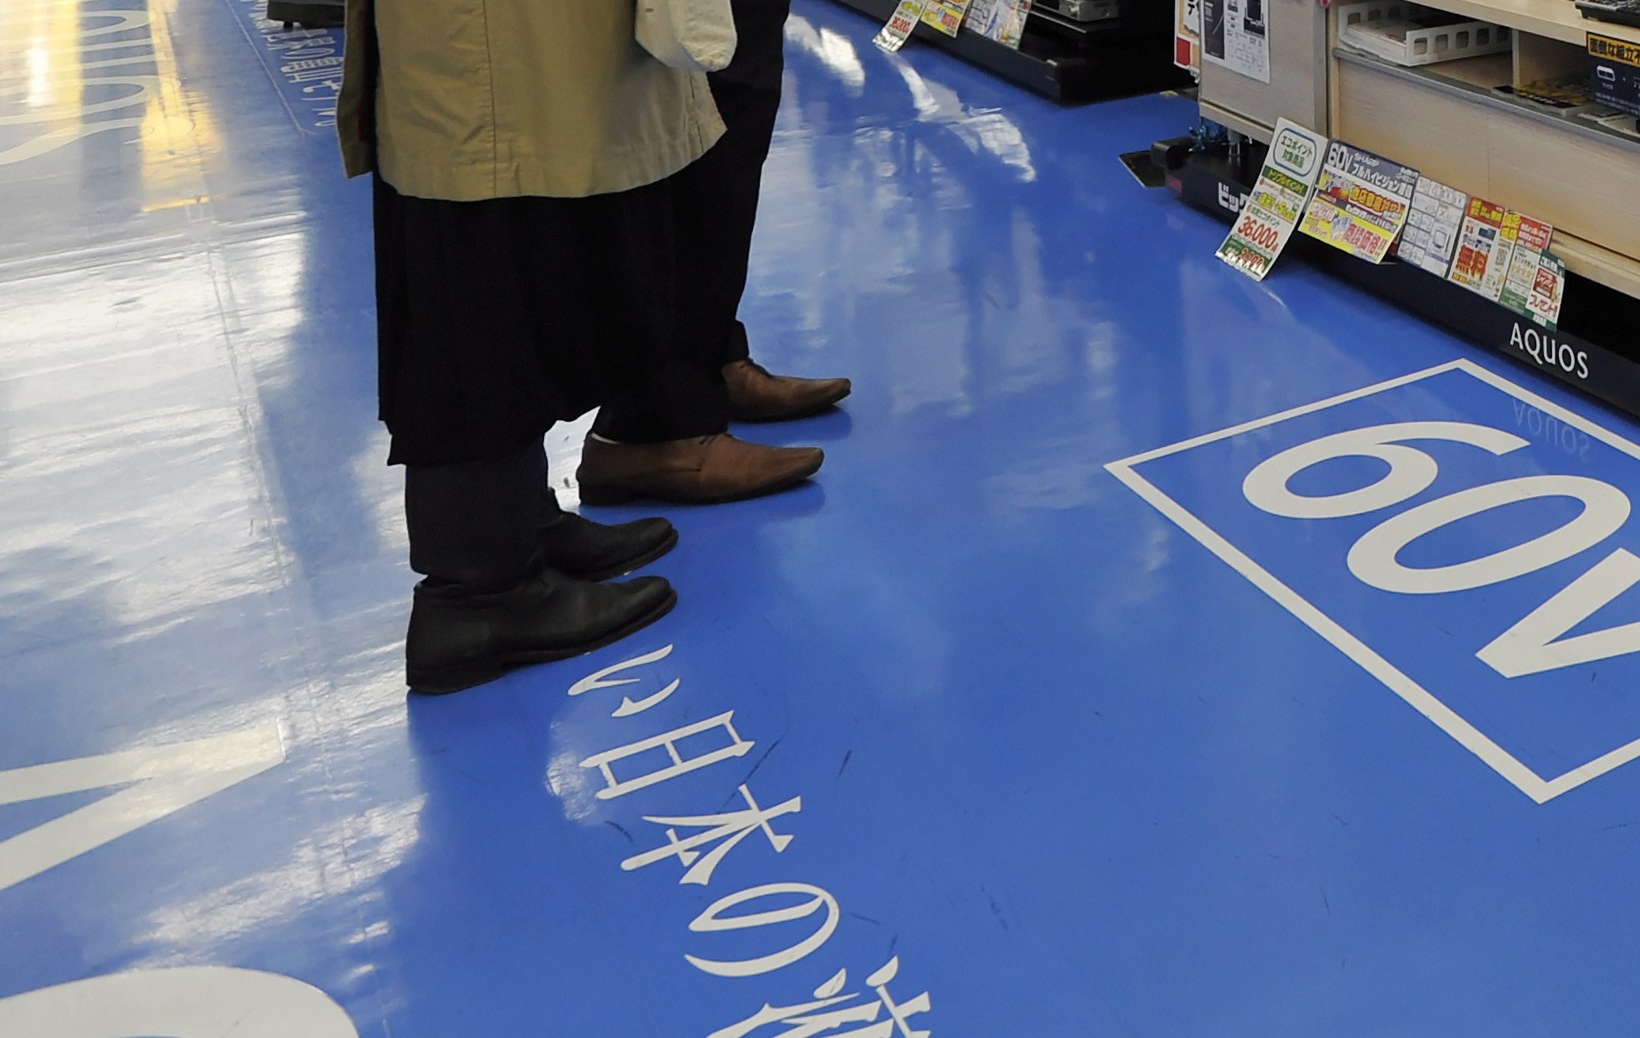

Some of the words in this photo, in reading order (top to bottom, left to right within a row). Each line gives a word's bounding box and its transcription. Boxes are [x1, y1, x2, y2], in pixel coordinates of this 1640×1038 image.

[1281, 135, 1313, 158] エコポイント
[1509, 322, 1590, 380] AQUOS
